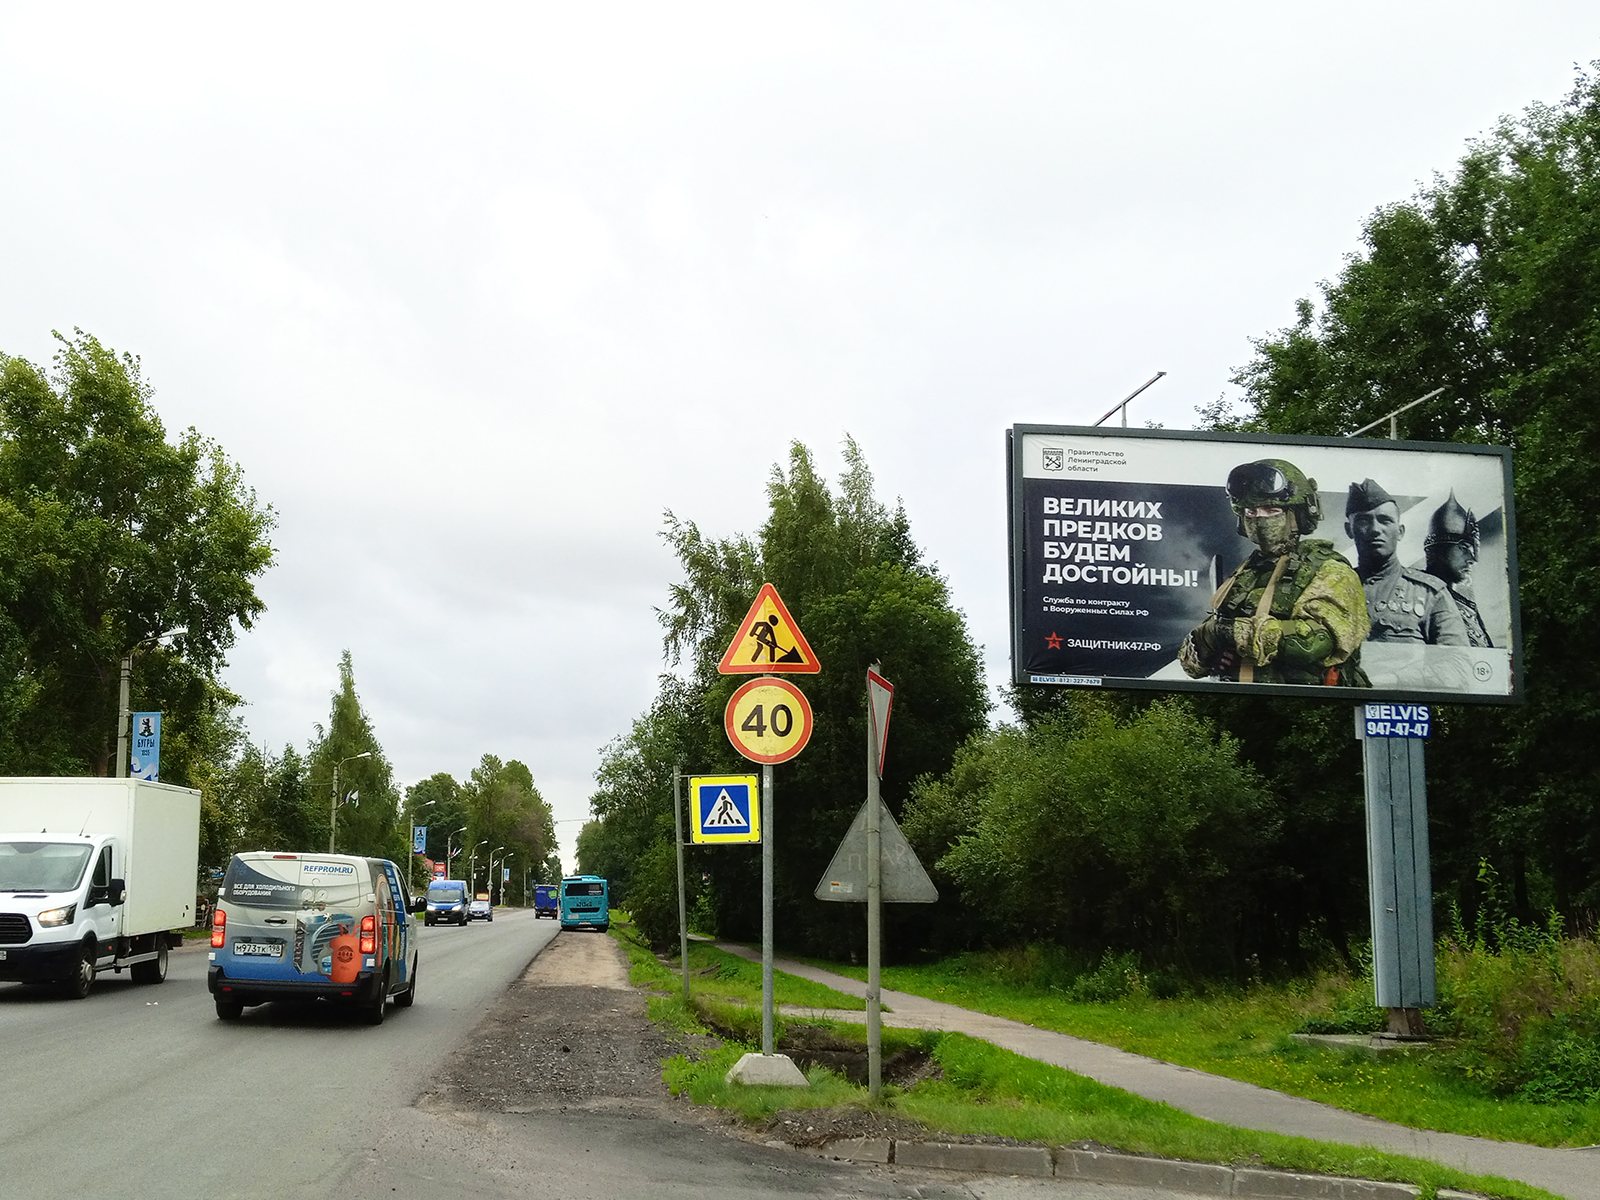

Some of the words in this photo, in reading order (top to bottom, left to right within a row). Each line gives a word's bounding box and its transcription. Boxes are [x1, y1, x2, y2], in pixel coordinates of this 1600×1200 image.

[1067, 449, 1124, 457] Правительство
[1067, 457, 1127, 465] Ленинградской
[1043, 497, 1163, 519] ВЕЛИКИХ
[1043, 519, 1163, 542] ПРЕДКОВ
[1043, 541, 1131, 562] БУДЕМ
[1042, 563, 1199, 587] ДОСТОЙНЫ!
[1042, 596, 1074, 605] Служба
[1088, 599, 1130, 608] контракту
[1050, 605, 1108, 615] Вооруженных
[1109, 608, 1135, 616] Силах
[1136, 609, 1149, 617] РФ
[1067, 638, 1162, 652] ЗАЩИТНИК47.РФ
[1476, 667, 1490, 676] 18+
[1381, 705, 1429, 720] ELVIS
[741, 703, 794, 738] 40
[1367, 721, 1429, 737] 947-47-47
[137, 739, 154, 747] БУГРЫ
[303, 865, 354, 874] REFPROM.RU
